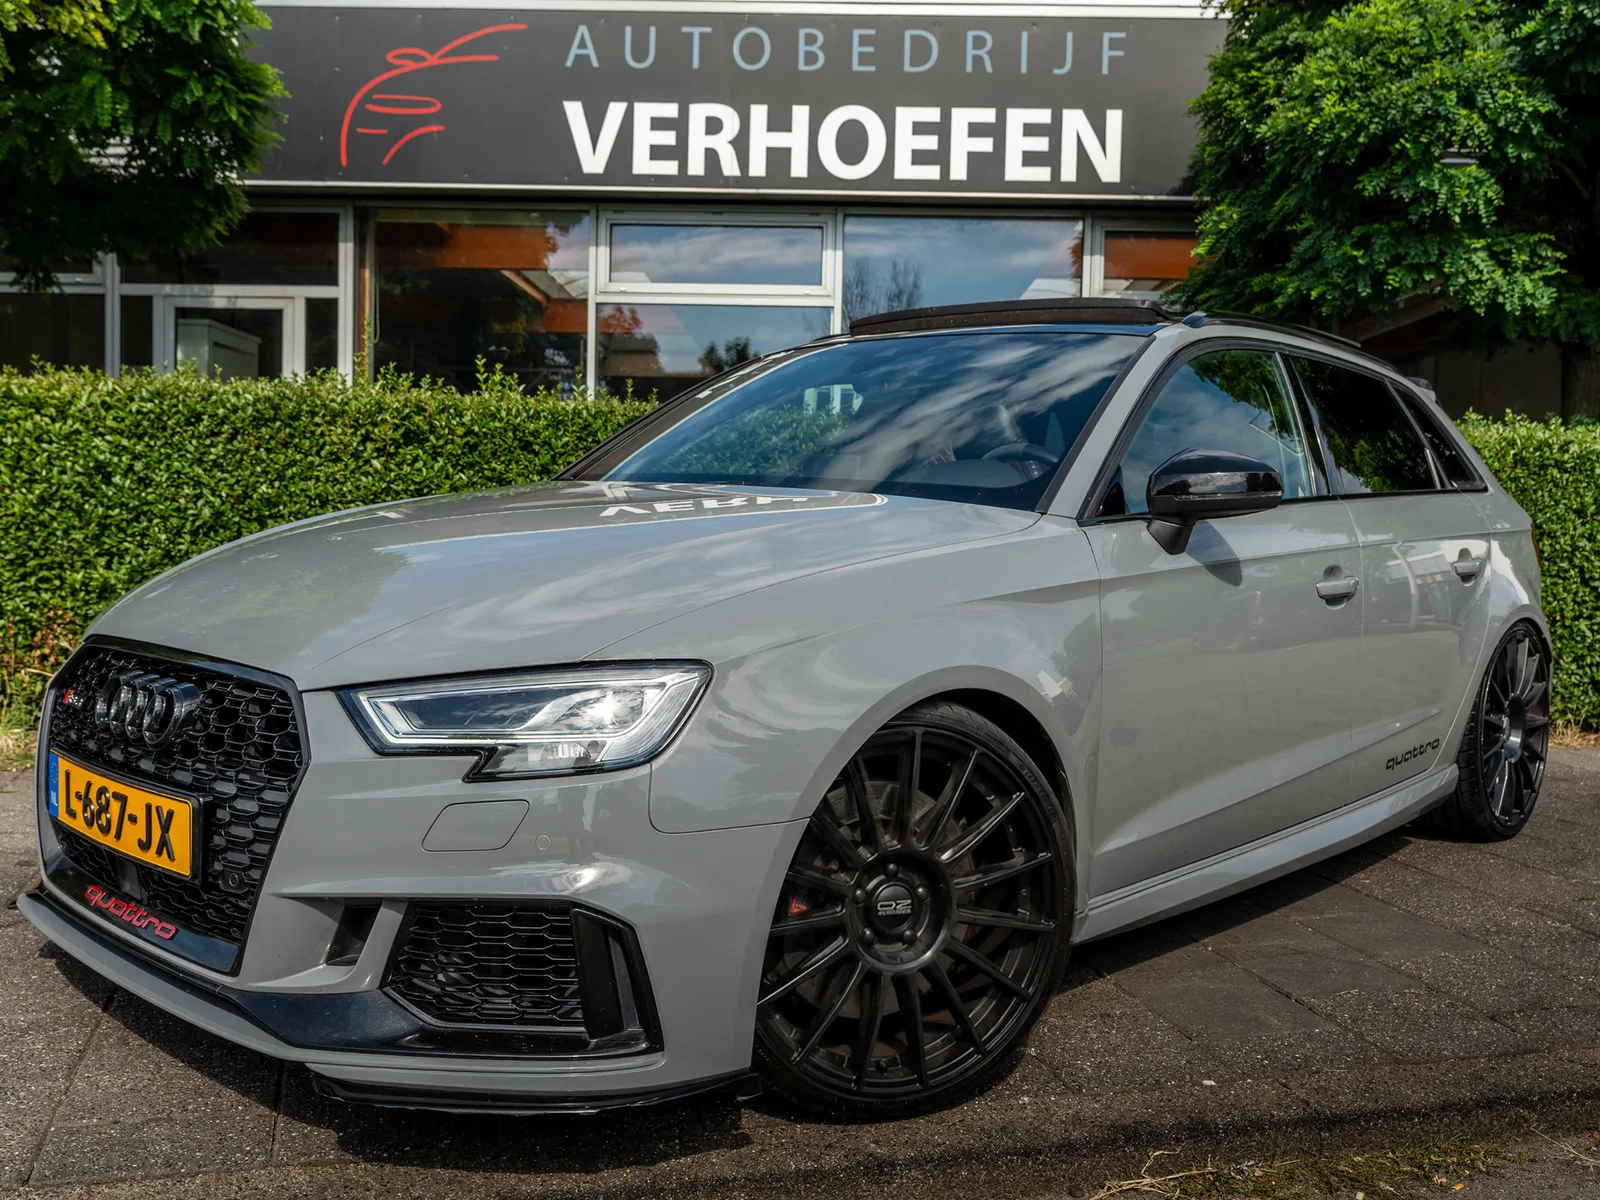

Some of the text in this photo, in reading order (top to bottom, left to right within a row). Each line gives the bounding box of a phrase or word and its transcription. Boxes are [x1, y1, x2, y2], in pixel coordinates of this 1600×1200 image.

[565, 25, 1126, 75] AUTOBEDRIJF
[563, 101, 1123, 183] VERHOEFEN
[1385, 738, 1440, 771] quattro
[65, 769, 176, 861] L-687-JX
[85, 885, 177, 940] quattro
[877, 900, 911, 910] OZ
